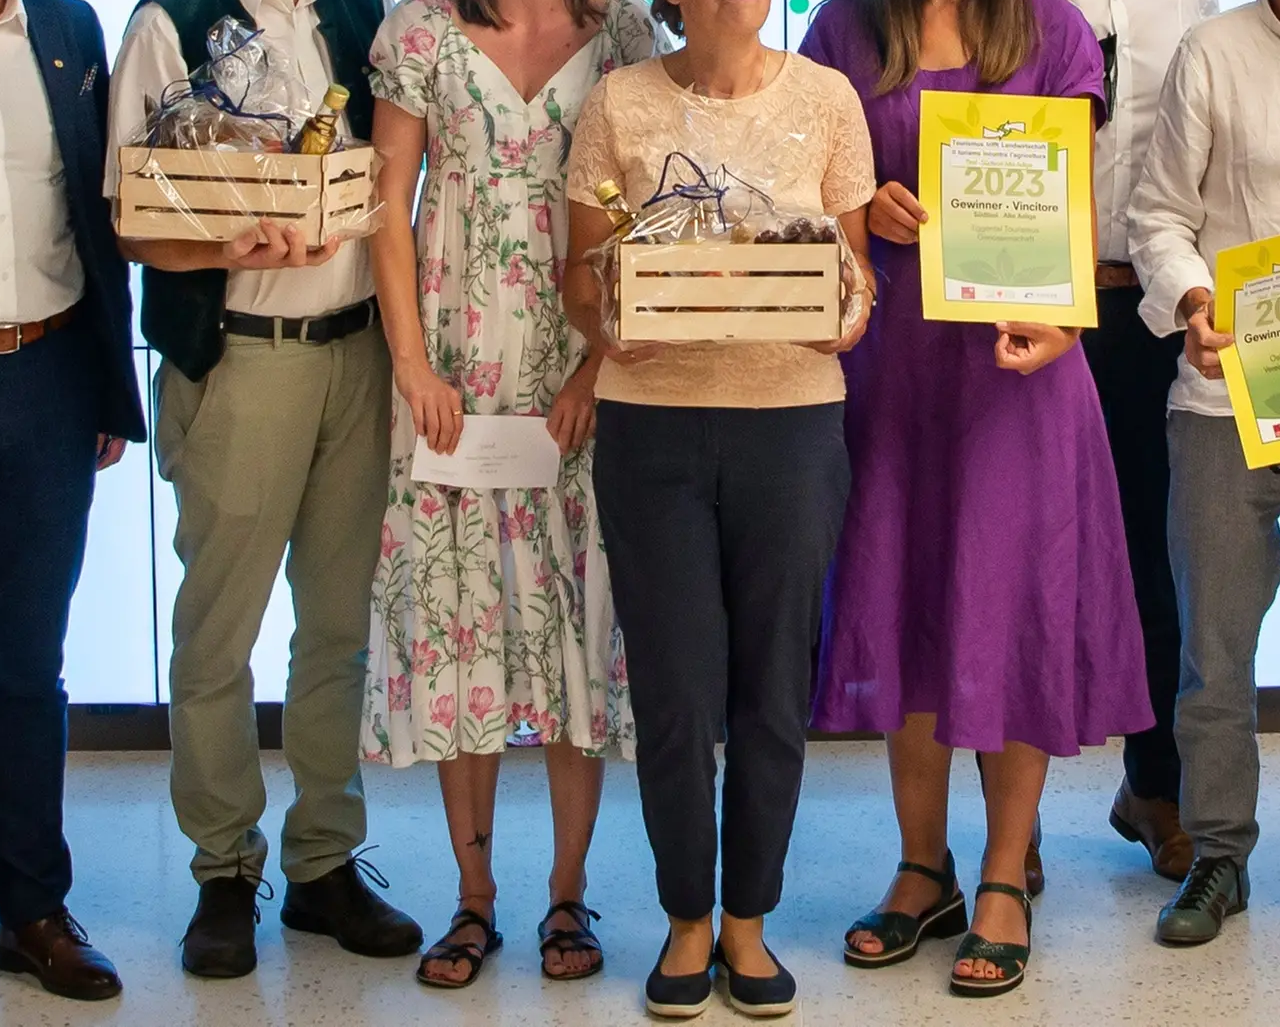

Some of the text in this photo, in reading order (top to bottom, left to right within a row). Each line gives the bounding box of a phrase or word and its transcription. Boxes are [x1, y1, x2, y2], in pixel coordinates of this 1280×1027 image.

[964, 167, 1045, 197] 2023
[950, 198, 1059, 213] Gewinner Vincitore
